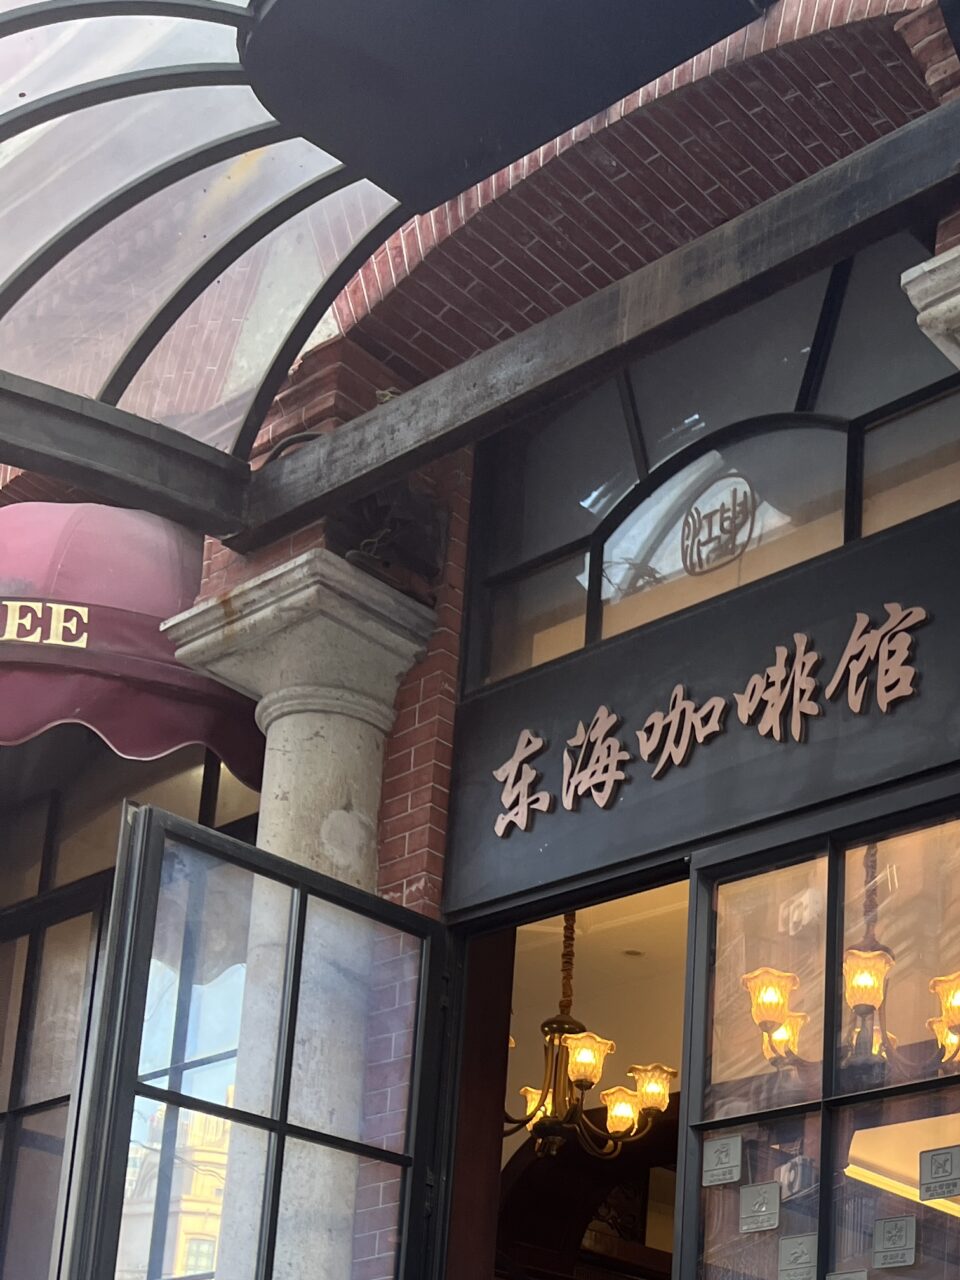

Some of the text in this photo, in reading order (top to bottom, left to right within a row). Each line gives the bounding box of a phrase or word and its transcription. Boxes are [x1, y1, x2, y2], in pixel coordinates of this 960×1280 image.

[1, 600, 89, 649] EE
[492, 602, 930, 838] 东海咖啡馆
